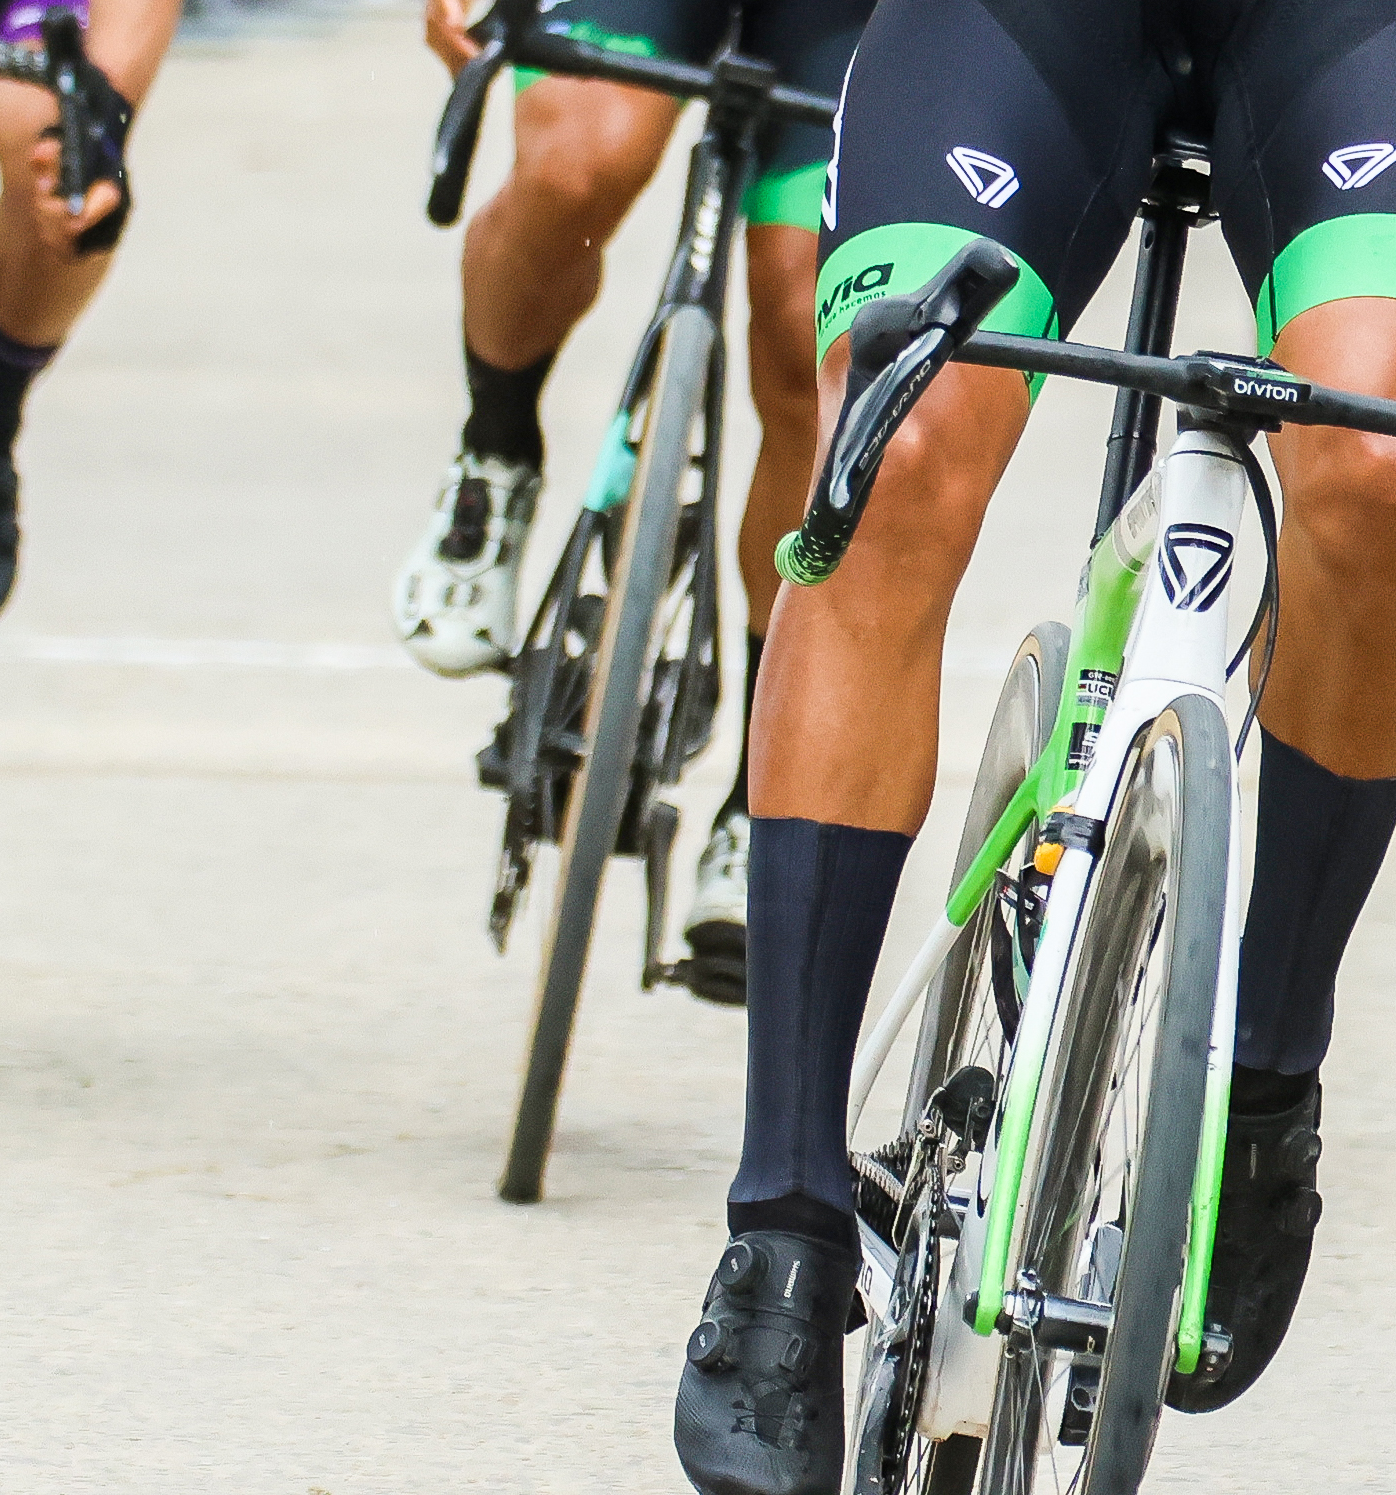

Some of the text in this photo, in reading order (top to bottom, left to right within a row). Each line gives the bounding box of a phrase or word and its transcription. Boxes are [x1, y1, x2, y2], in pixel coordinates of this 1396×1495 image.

[818, 262, 895, 336] via
[839, 289, 887, 314] hacemos
[1087, 682, 1113, 696] UCI
